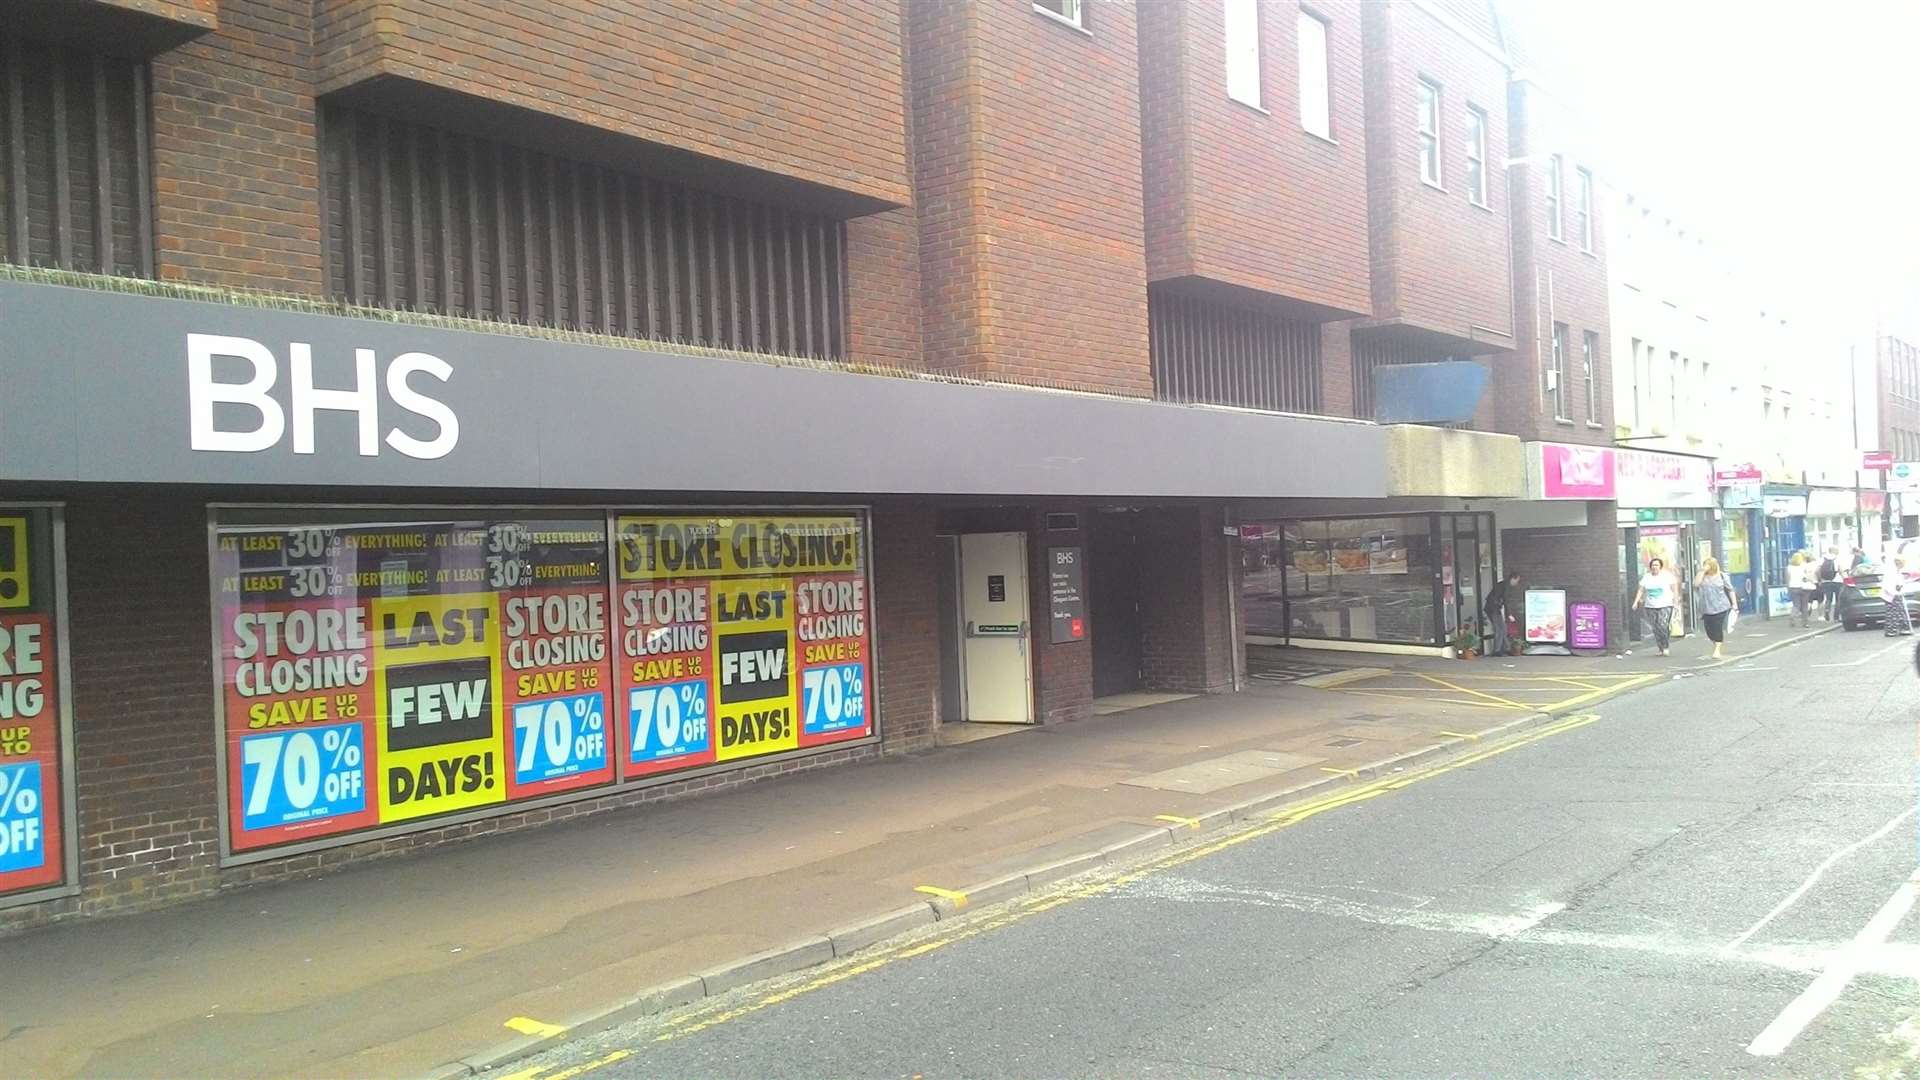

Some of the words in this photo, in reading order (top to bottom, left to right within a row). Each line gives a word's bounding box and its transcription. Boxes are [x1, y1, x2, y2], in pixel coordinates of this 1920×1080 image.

[187, 333, 460, 460] BHS
[221, 537, 239, 551] AT
[243, 535, 283, 551] LEAST
[325, 546, 341, 557] OFF
[346, 533, 427, 550] EVERYTHING!
[434, 533, 448, 547] AT
[452, 532, 484, 547] LEAST
[623, 523, 722, 573] STORE
[732, 522, 852, 569] CLOSING!
[1056, 552, 1074, 564] BHS
[222, 577, 239, 592] AT
[244, 575, 285, 591] LEAST
[327, 585, 344, 596] OFF
[347, 570, 428, 587] EVERYTHING!
[436, 570, 450, 583] AT
[454, 568, 486, 582] LEAST
[519, 576, 533, 586] OFF
[535, 563, 600, 579] EVERYTHING!
[623, 588, 707, 627] STORE
[718, 591, 786, 622] LAST
[798, 580, 865, 615] STORE
[384, 608, 489, 650] LAST
[506, 593, 604, 637] STORE
[798, 614, 865, 642] CLOSING
[233, 607, 367, 659] STORE
[625, 624, 708, 657] CLOSING
[507, 633, 605, 670] CLOSING
[722, 648, 785, 686] FEW
[805, 643, 844, 663] SAVE
[849, 642, 860, 651] UP
[849, 650, 860, 659] TO
[235, 653, 368, 697] CLOSING
[518, 670, 576, 697] SAVE
[582, 668, 598, 679] UP
[582, 678, 598, 688] TO
[633, 658, 683, 682] SAVE
[688, 656, 702, 666] UP
[688, 665, 702, 675] TO
[248, 697, 328, 729] SAVE
[335, 694, 357, 706] UP
[336, 706, 358, 717] TO
[391, 679, 487, 728] FEW
[844, 697, 863, 718] OFF
[1, 726, 31, 741] UP
[683, 717, 706, 744] OFF
[721, 707, 790, 748] DAYS!
[2, 740, 32, 756] TO
[575, 732, 603, 761] OFF
[324, 769, 361, 802] OFF
[388, 752, 494, 805] DAYS!
